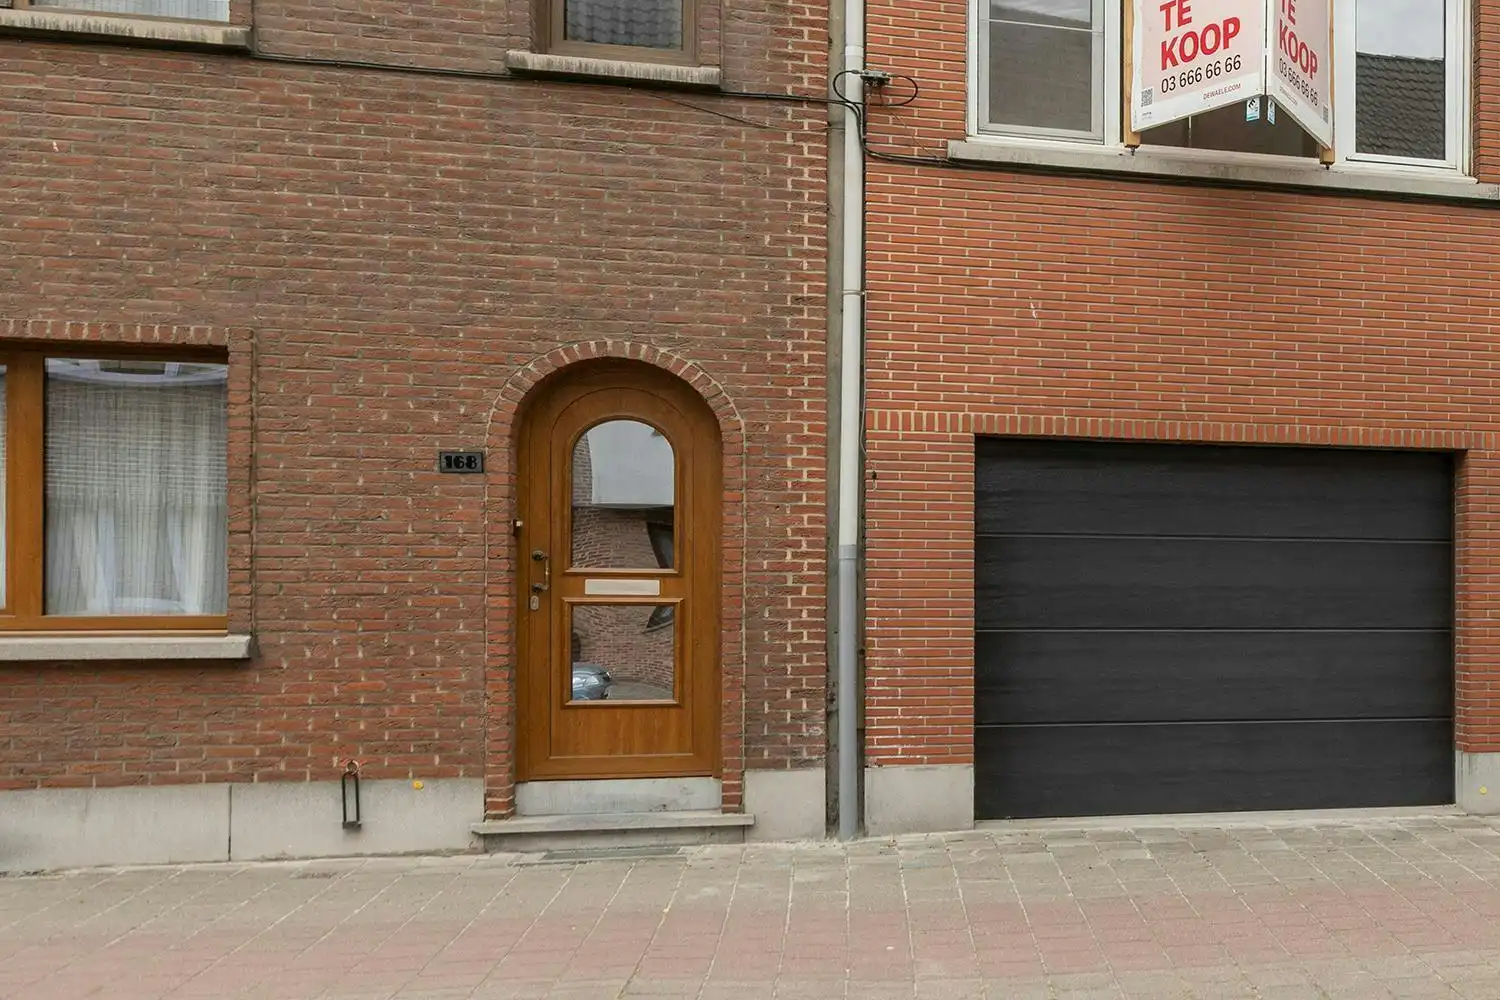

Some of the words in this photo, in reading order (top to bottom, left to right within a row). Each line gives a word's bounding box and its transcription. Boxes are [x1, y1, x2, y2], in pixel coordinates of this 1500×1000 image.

[1161, 16, 1241, 71] KOOP
[1279, 18, 1318, 80] KOOP
[1161, 75, 1176, 94] 03
[1179, 66, 1202, 88] 666
[1205, 60, 1221, 79] 66
[1224, 54, 1241, 73] 66
[444, 455, 477, 470] 168
